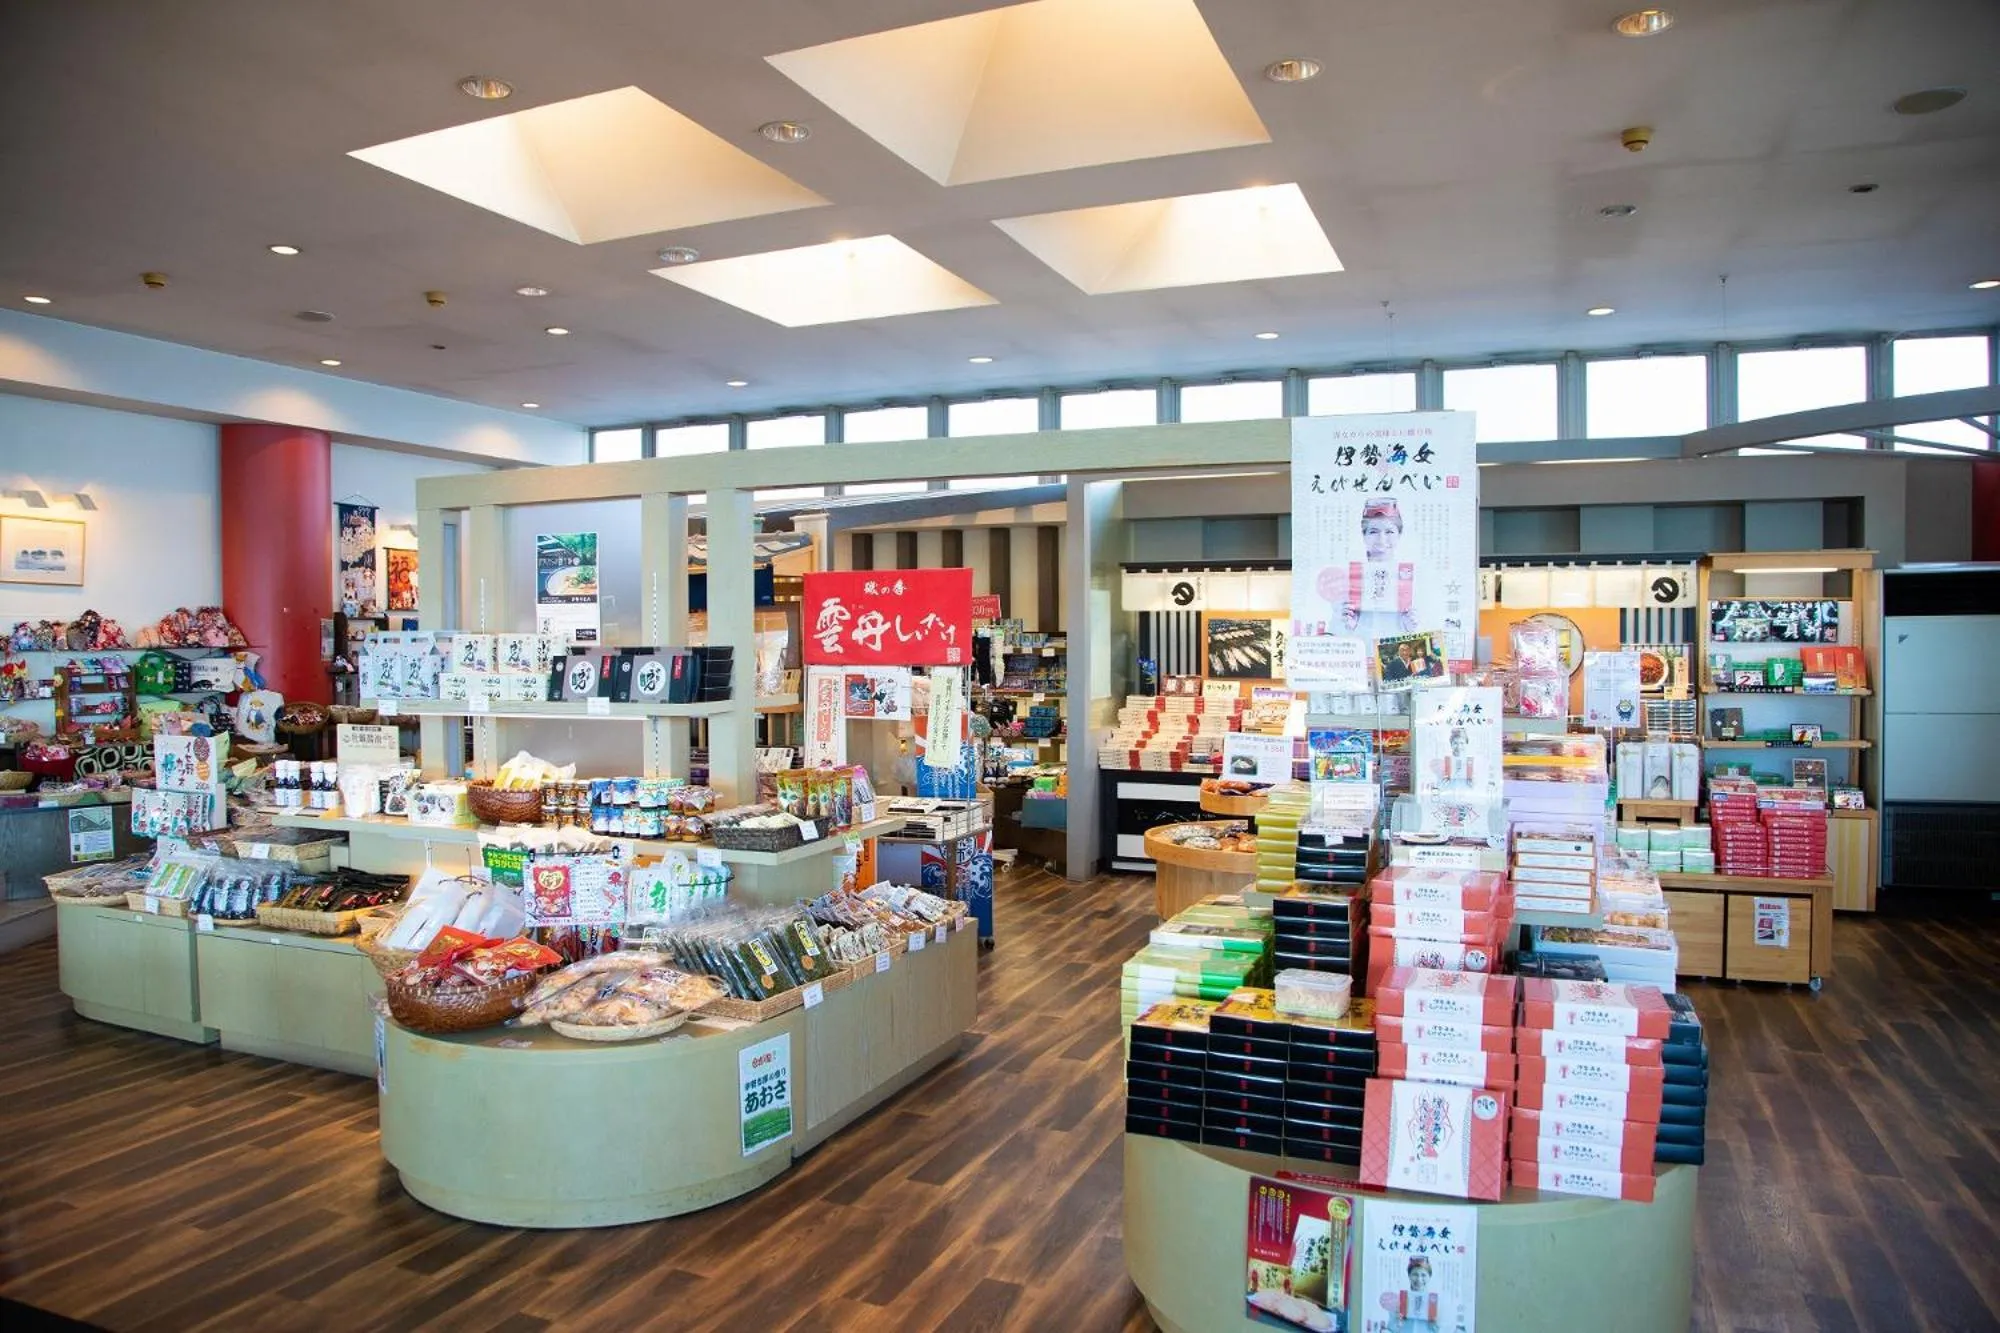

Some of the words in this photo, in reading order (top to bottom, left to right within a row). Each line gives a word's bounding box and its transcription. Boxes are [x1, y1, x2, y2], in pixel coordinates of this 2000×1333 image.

[1334, 443, 1435, 466] 伊勢海女
[1311, 473, 1441, 494] えびせんべい
[744, 1080, 786, 1114] あおさ
